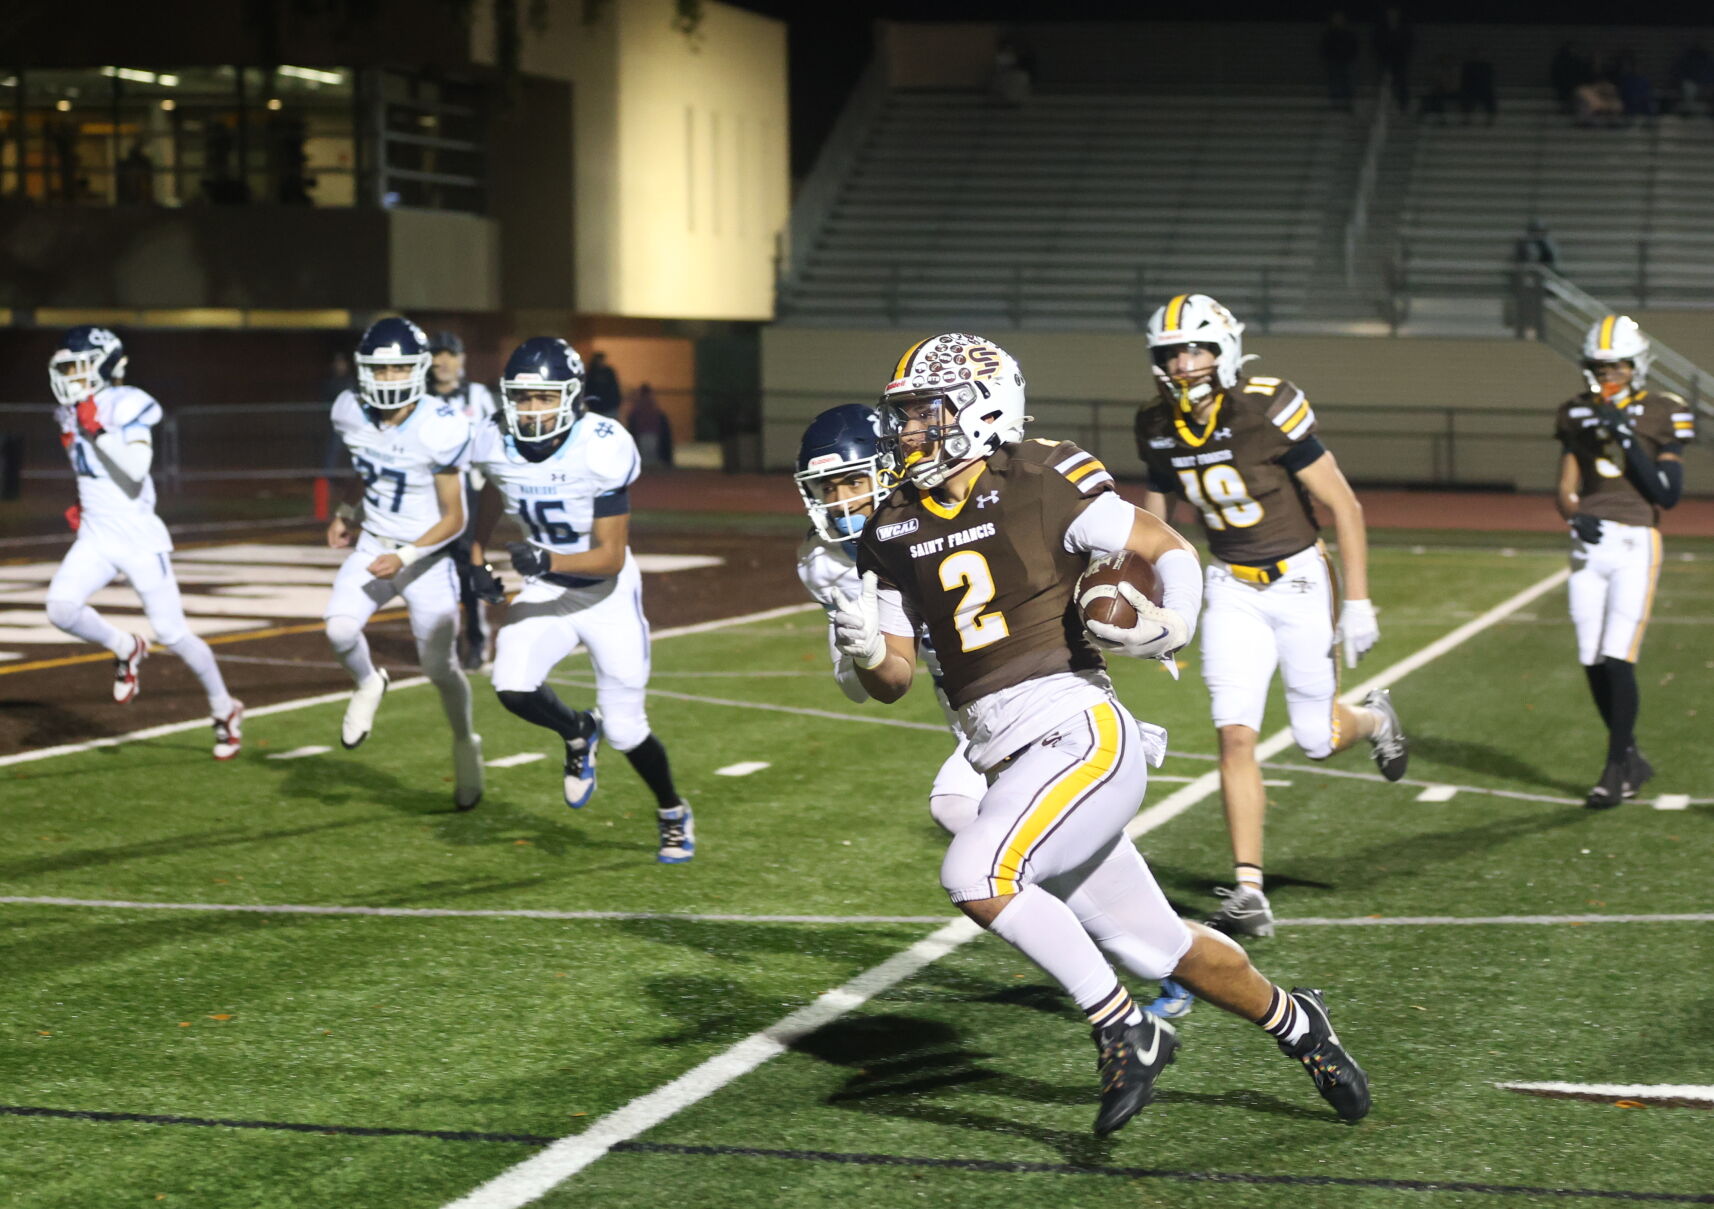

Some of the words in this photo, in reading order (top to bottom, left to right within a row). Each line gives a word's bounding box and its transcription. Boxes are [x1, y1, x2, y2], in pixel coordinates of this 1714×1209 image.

[356, 455, 407, 513] 27
[519, 499, 579, 545] 16
[877, 519, 917, 540] WCAL
[909, 538, 944, 558] SAINT
[947, 522, 996, 548] FRANCIS
[938, 550, 1010, 653] 2
